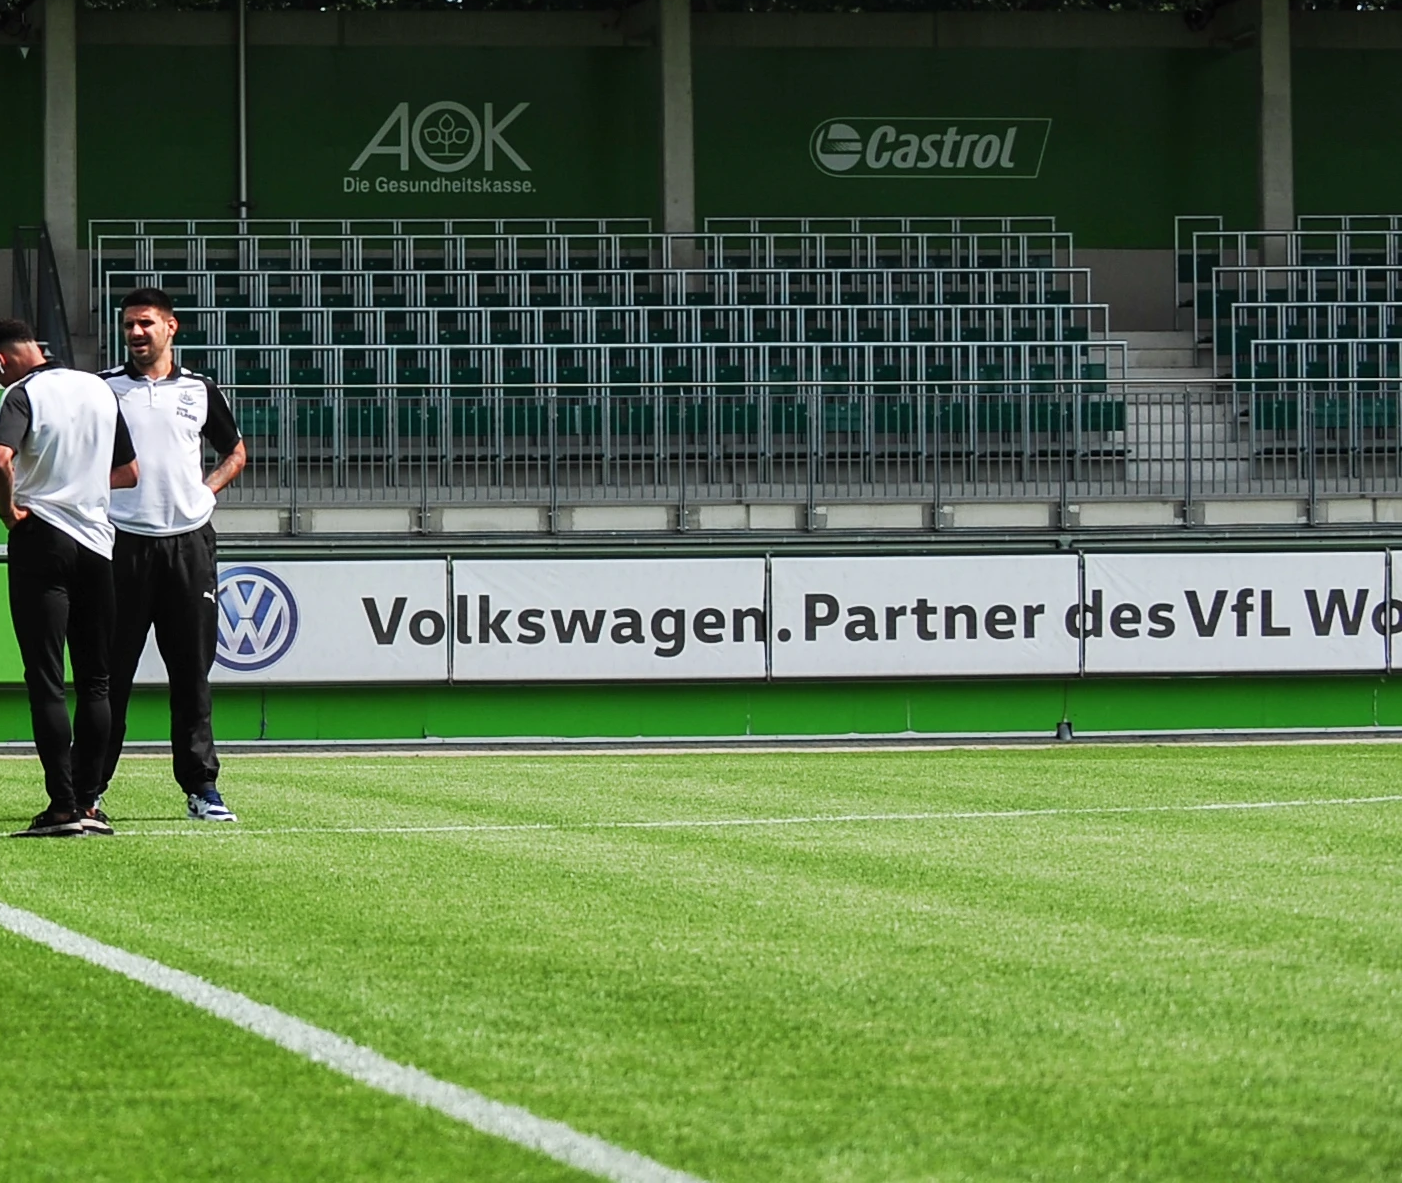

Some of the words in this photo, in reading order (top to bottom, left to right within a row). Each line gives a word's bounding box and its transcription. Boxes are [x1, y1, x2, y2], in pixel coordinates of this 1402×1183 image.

[348, 101, 533, 173] AOK
[865, 124, 1018, 169] Castrol
[343, 177, 370, 193] Die
[375, 177, 537, 193] Gesundheitskasse.
[361, 594, 792, 658] Volkswagen.
[804, 593, 1045, 642] Partner
[1064, 589, 1176, 639] des
[1183, 588, 1291, 637] VfL
